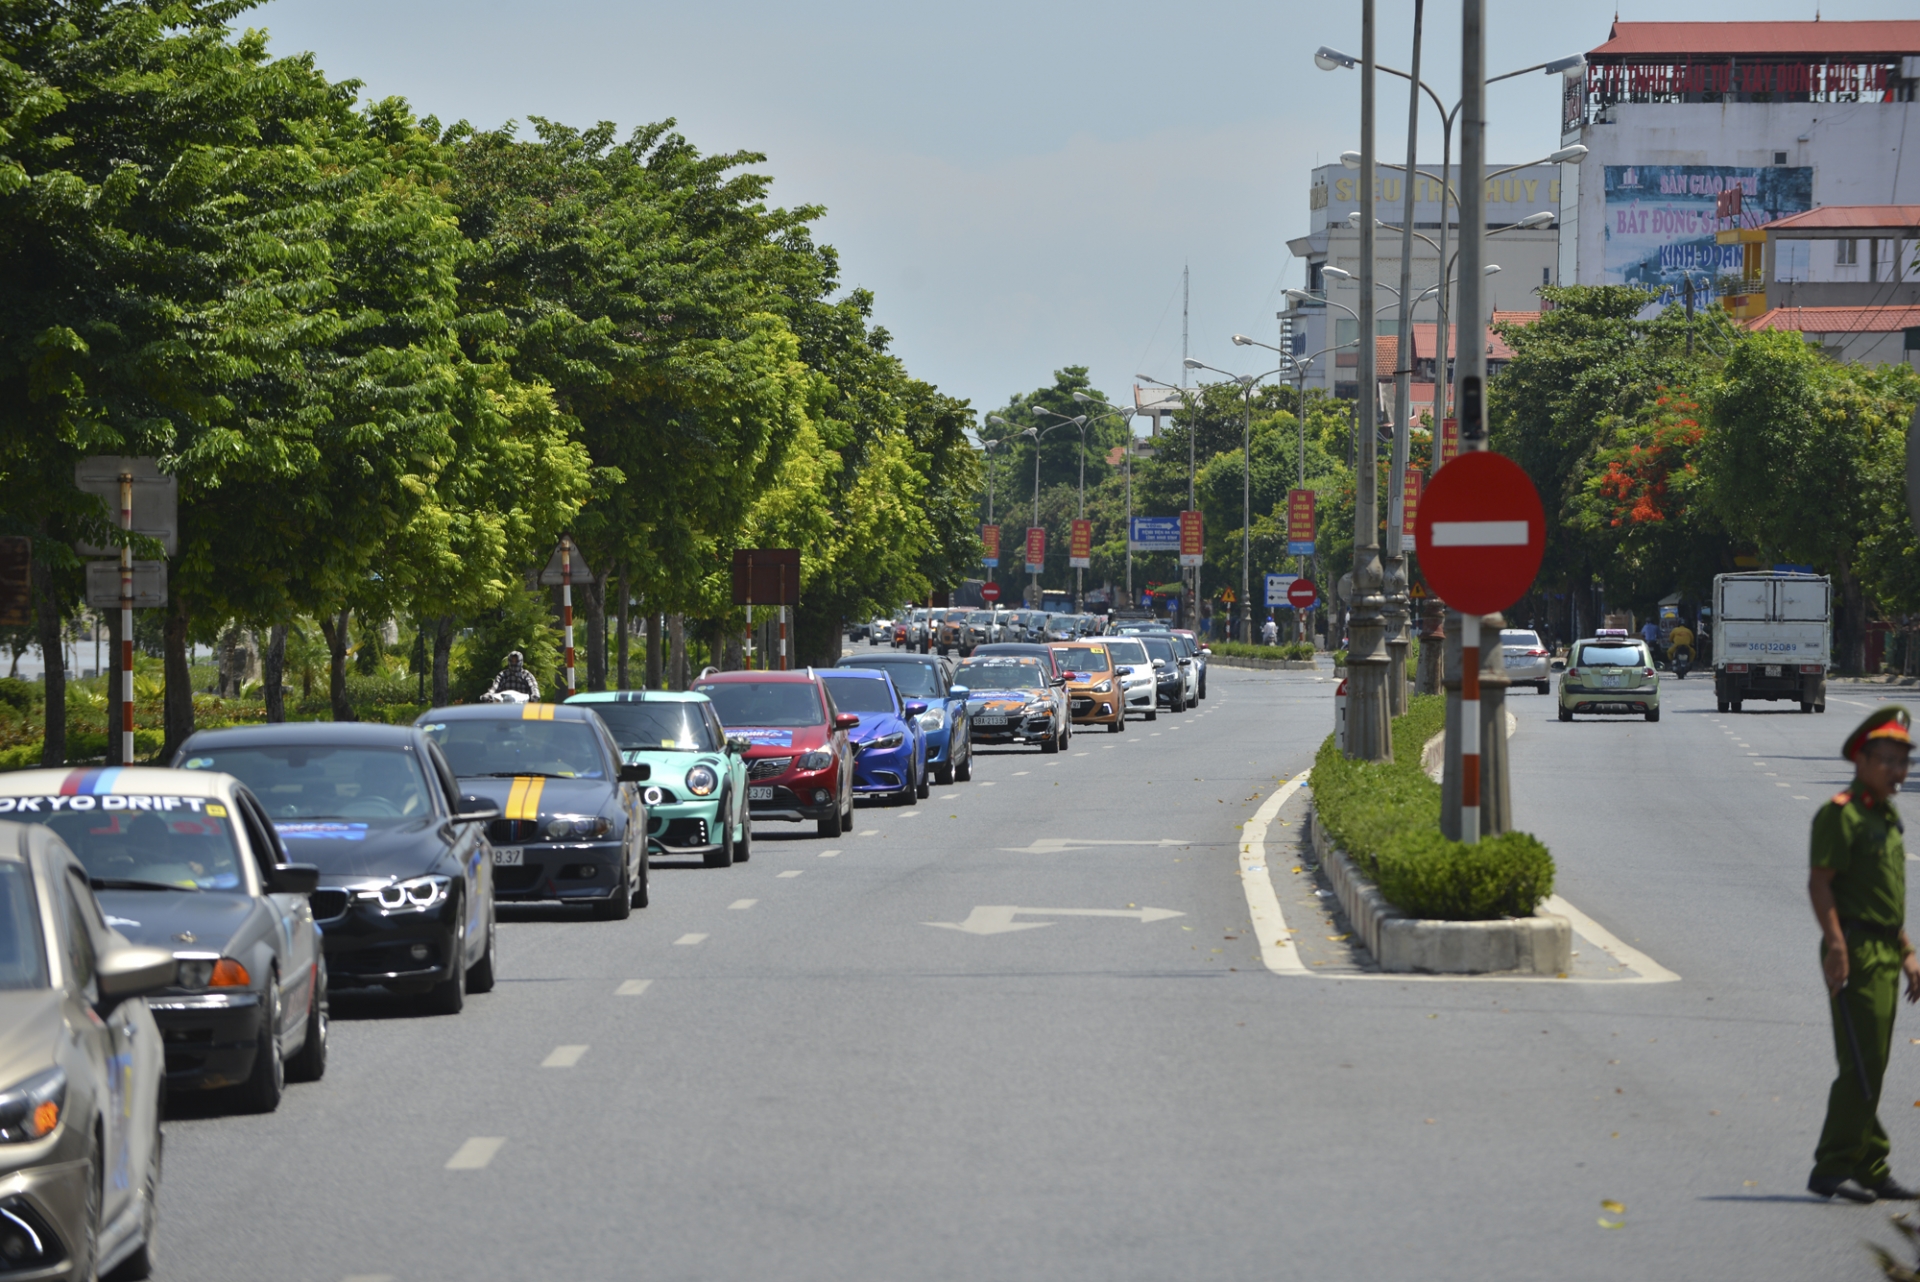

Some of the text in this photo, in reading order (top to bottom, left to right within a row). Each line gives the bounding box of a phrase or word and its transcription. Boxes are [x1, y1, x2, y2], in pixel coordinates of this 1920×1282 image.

[1626, 64, 1668, 93] TNHH
[1710, 62, 1733, 93] TƯ
[1741, 58, 1773, 93] XÂY
[1776, 61, 1821, 99] DỰNG
[1483, 173, 1540, 203] HÚY
[1660, 170, 1687, 195] SÀN
[1689, 175, 1723, 196] GIAO
[1616, 198, 1649, 234] BẤT
[1652, 203, 1698, 239] ĐỘNG
[1659, 245, 1744, 269] KINH DOAN
[102, 795, 205, 812] DRIFT
